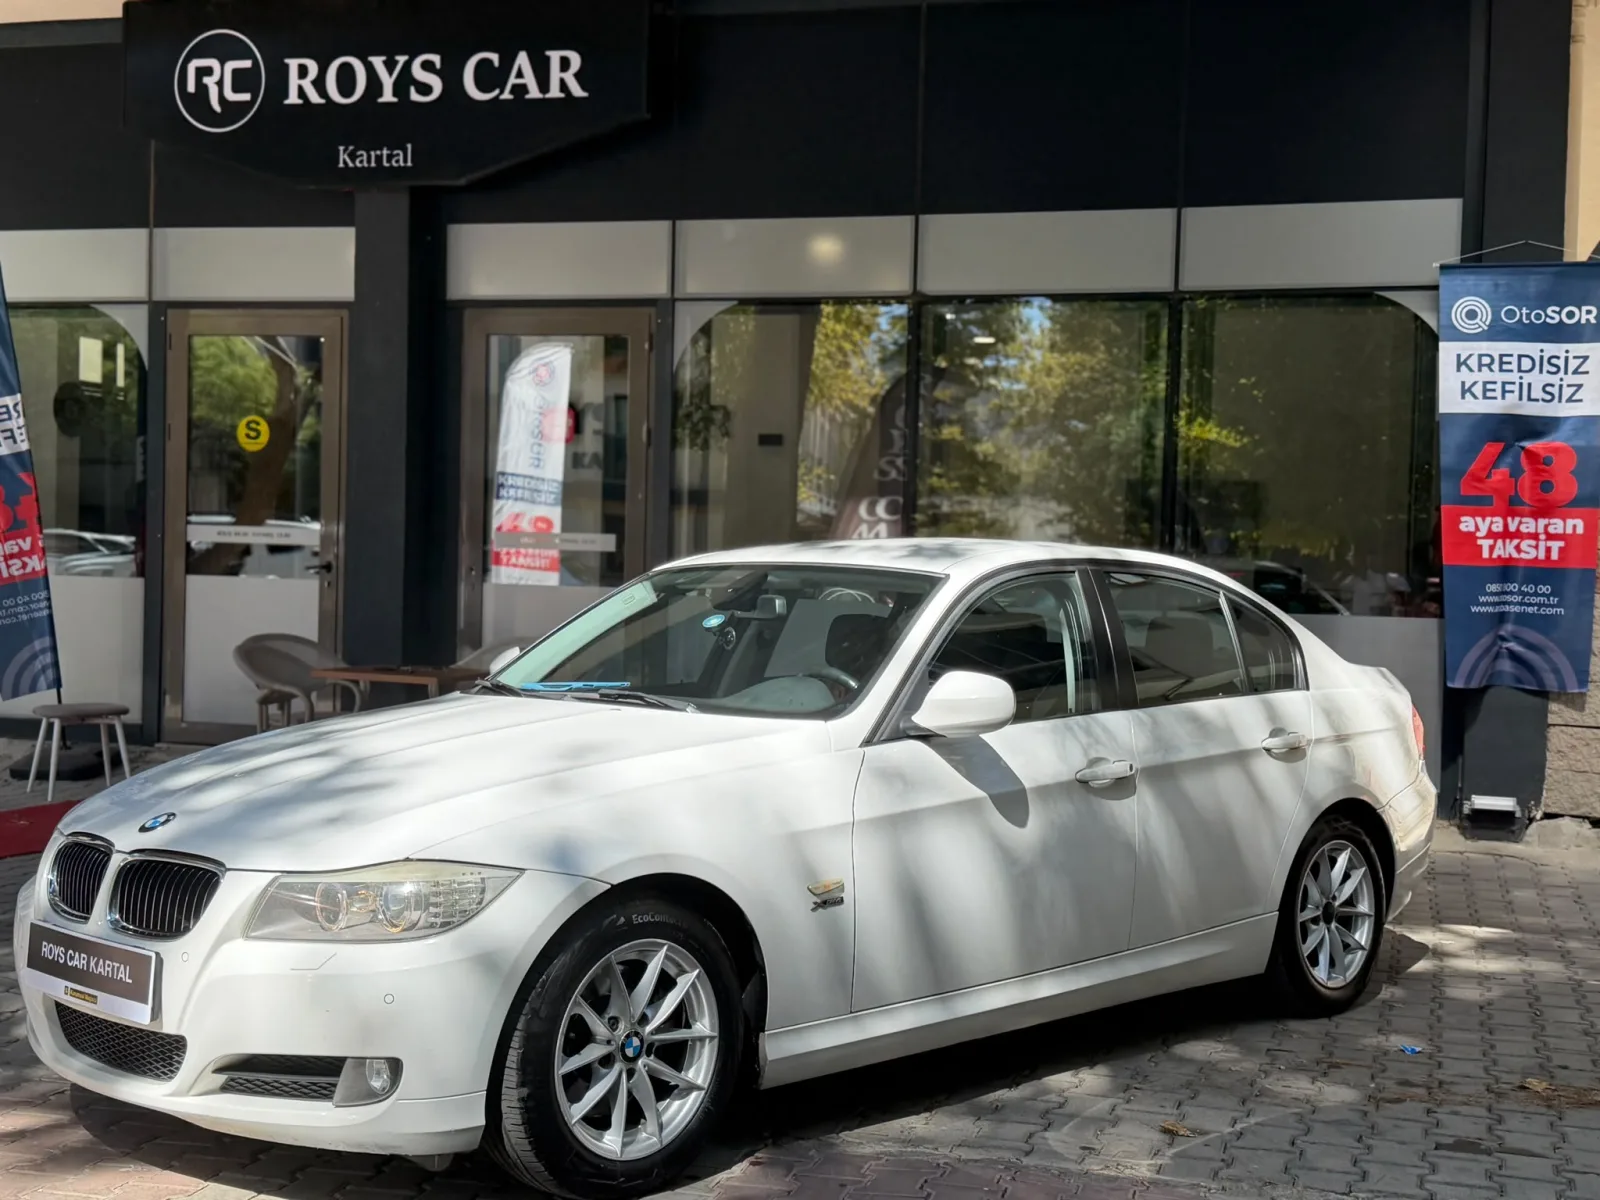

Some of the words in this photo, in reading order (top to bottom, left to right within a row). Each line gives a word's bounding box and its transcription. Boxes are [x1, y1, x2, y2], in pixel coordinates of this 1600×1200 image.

[186, 57, 253, 114] RC
[283, 53, 443, 105] ROYS
[462, 49, 589, 101] CAR
[337, 143, 413, 168] Kartal
[1500, 305, 1598, 325] OtoSOR
[1455, 348, 1591, 376] KREDİSİZ
[1460, 375, 1584, 404] KEFİLSİZ
[244, 419, 262, 440] S
[1460, 441, 1579, 508] 48
[1459, 515, 1504, 537] aya
[1507, 516, 1584, 535] varan
[1476, 534, 1565, 561] TAKSİT
[1521, 584, 1535, 593] 40
[1537, 585, 1551, 594] 00
[41, 941, 65, 964] ROYS
[66, 950, 87, 971] CAR
[89, 955, 133, 983] KARTAL
